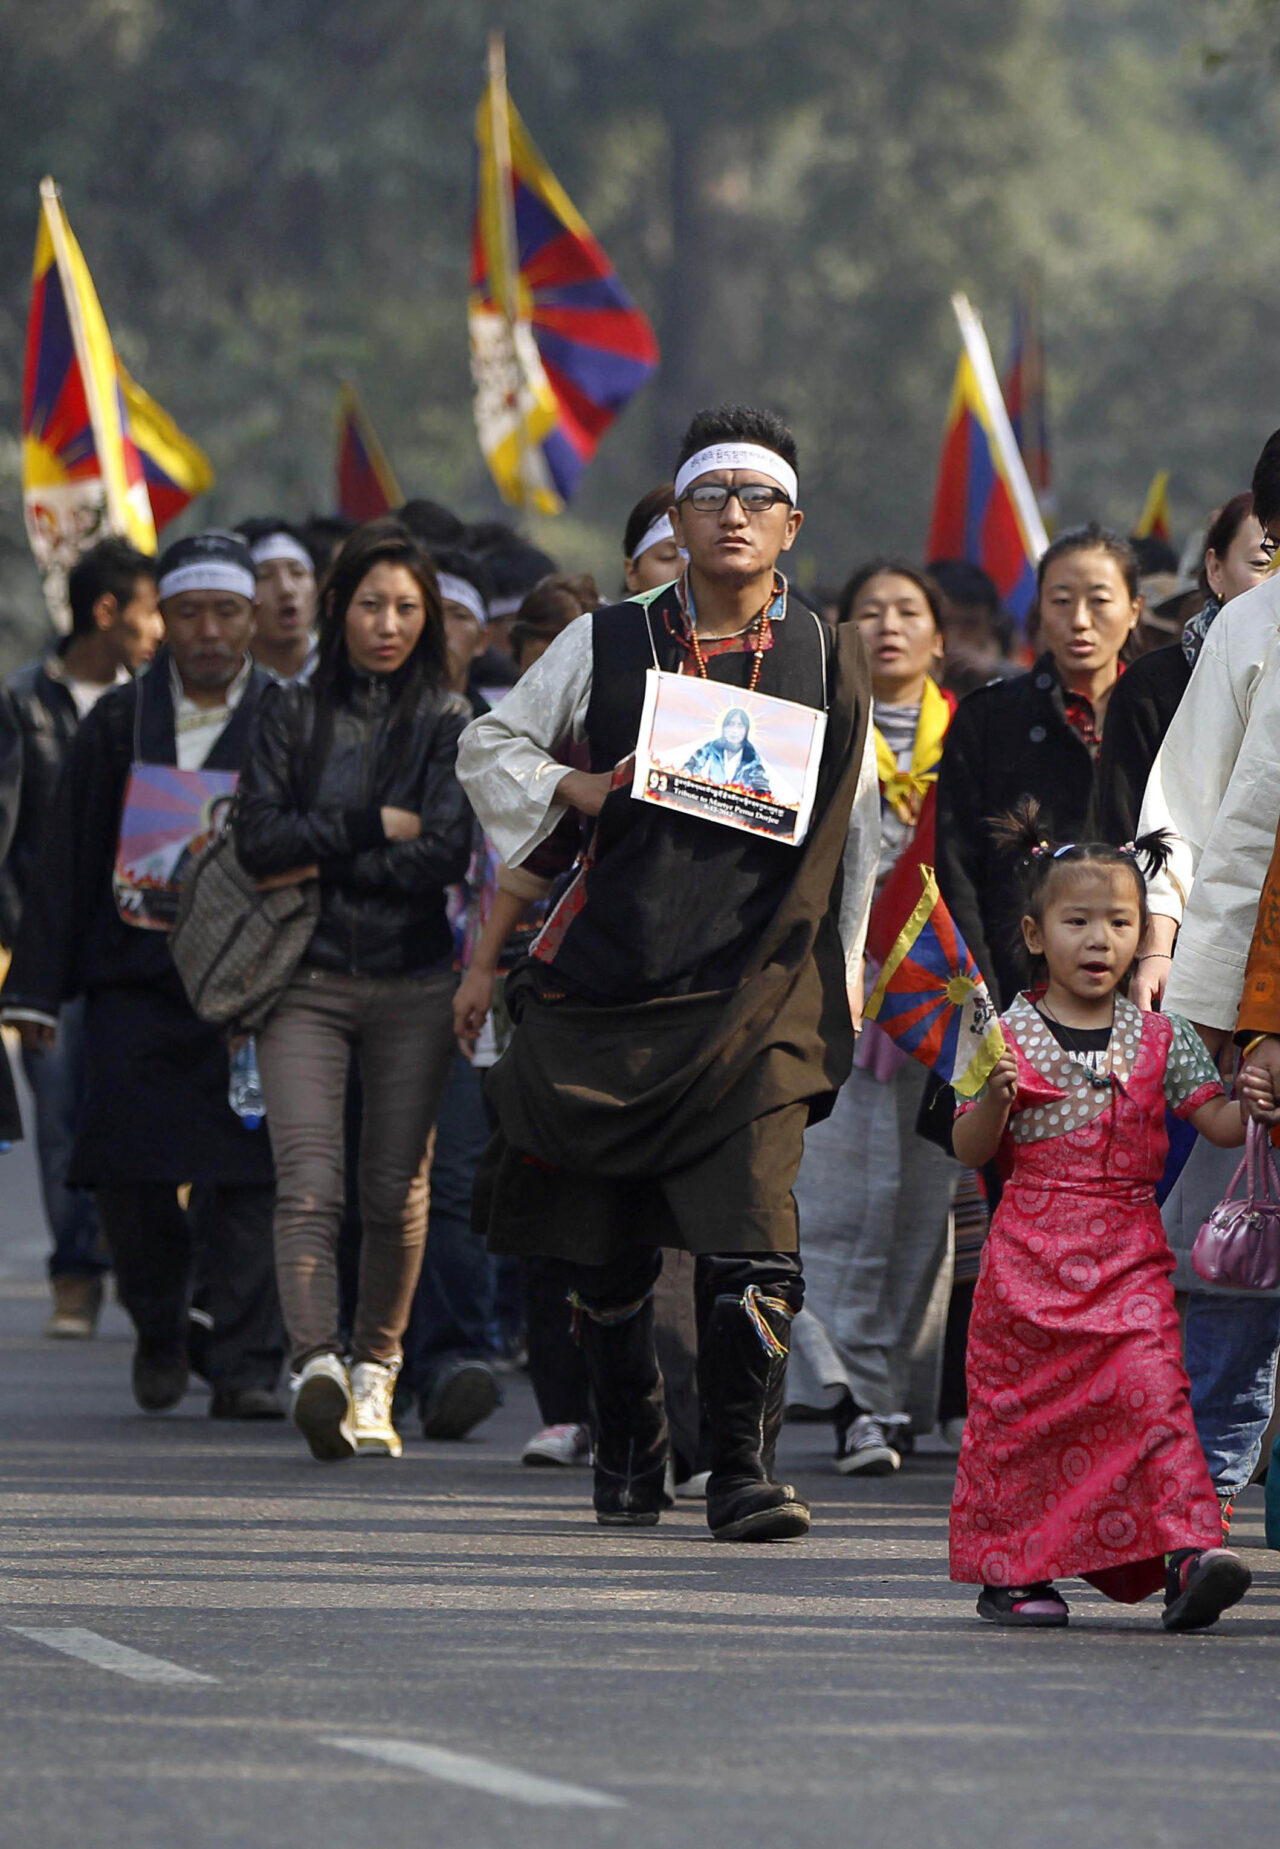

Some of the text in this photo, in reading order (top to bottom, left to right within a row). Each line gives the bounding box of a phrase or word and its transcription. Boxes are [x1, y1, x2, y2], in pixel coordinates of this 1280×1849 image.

[650, 772, 668, 792] 93
[673, 787, 699, 801] Tribute
[709, 798, 733, 812] Martyr
[735, 805, 754, 817] Pema
[755, 812, 780, 825] Dorjee
